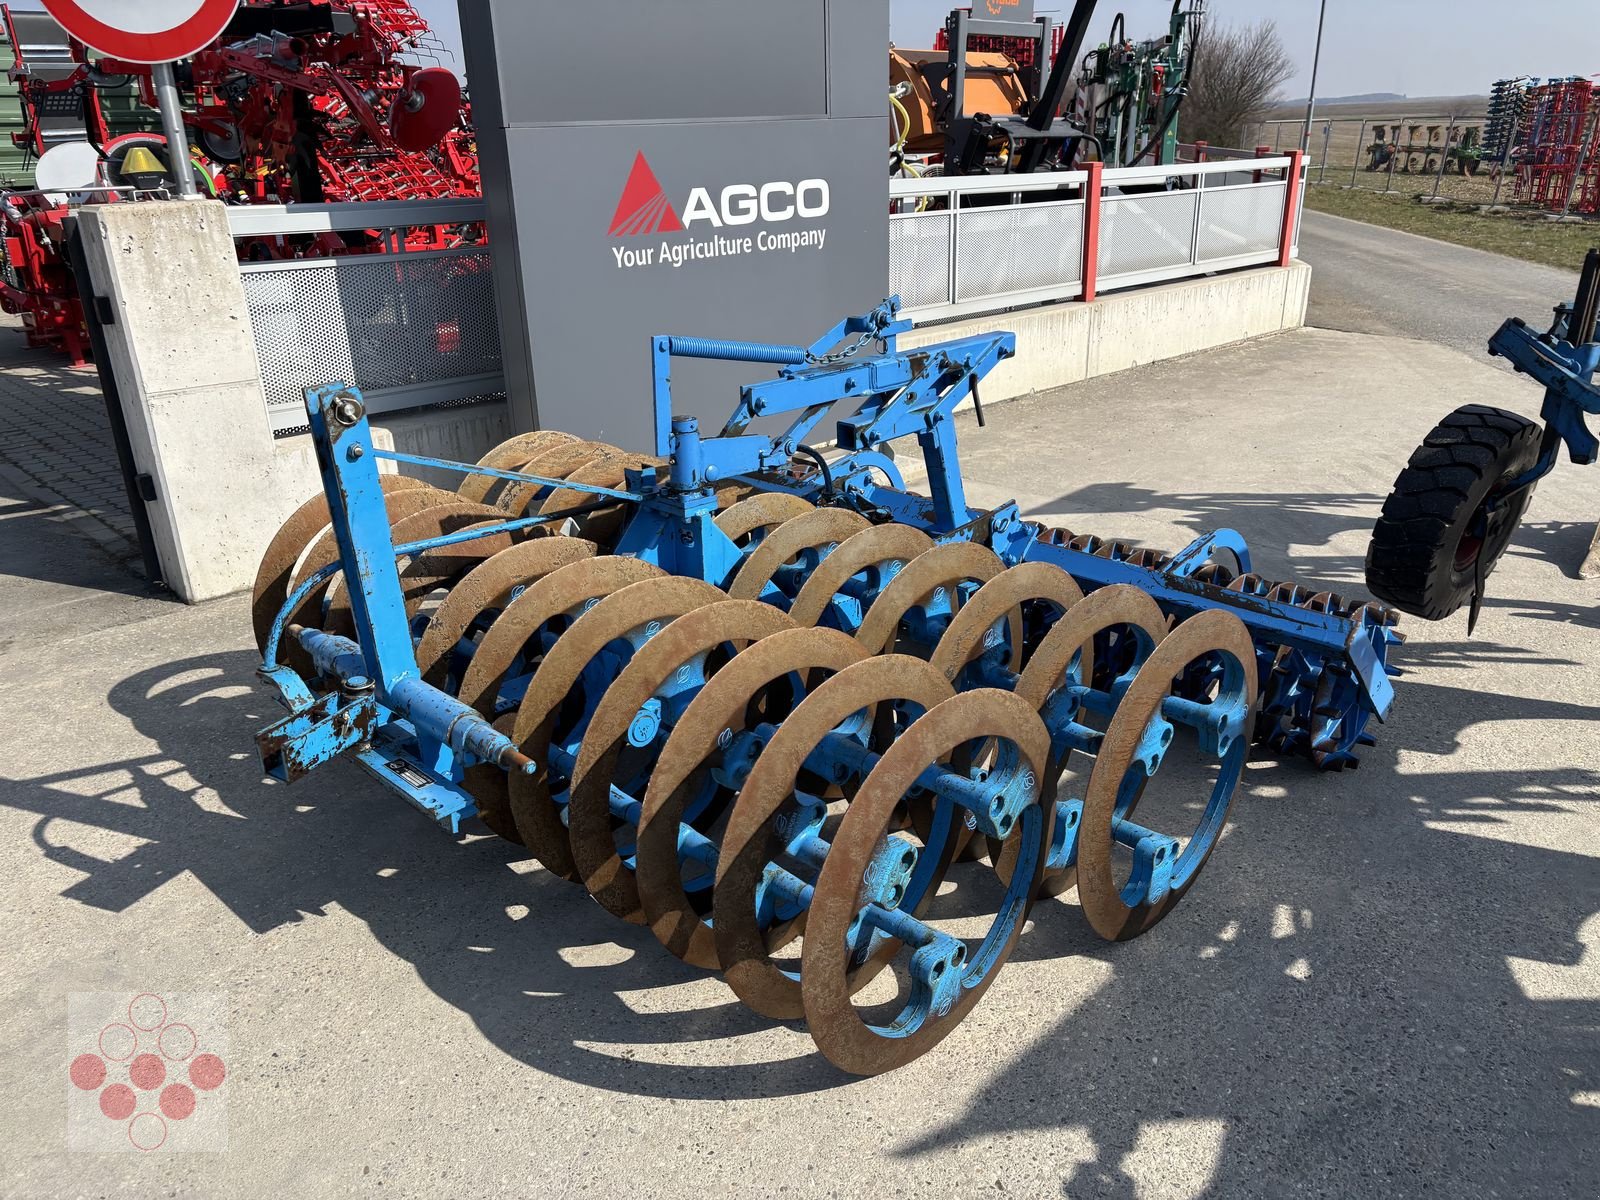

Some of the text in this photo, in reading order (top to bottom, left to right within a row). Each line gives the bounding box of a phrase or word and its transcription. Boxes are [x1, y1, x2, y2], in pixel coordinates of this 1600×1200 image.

[681, 178, 830, 230] AGCO
[611, 229, 826, 268] Your Agriculture Company
